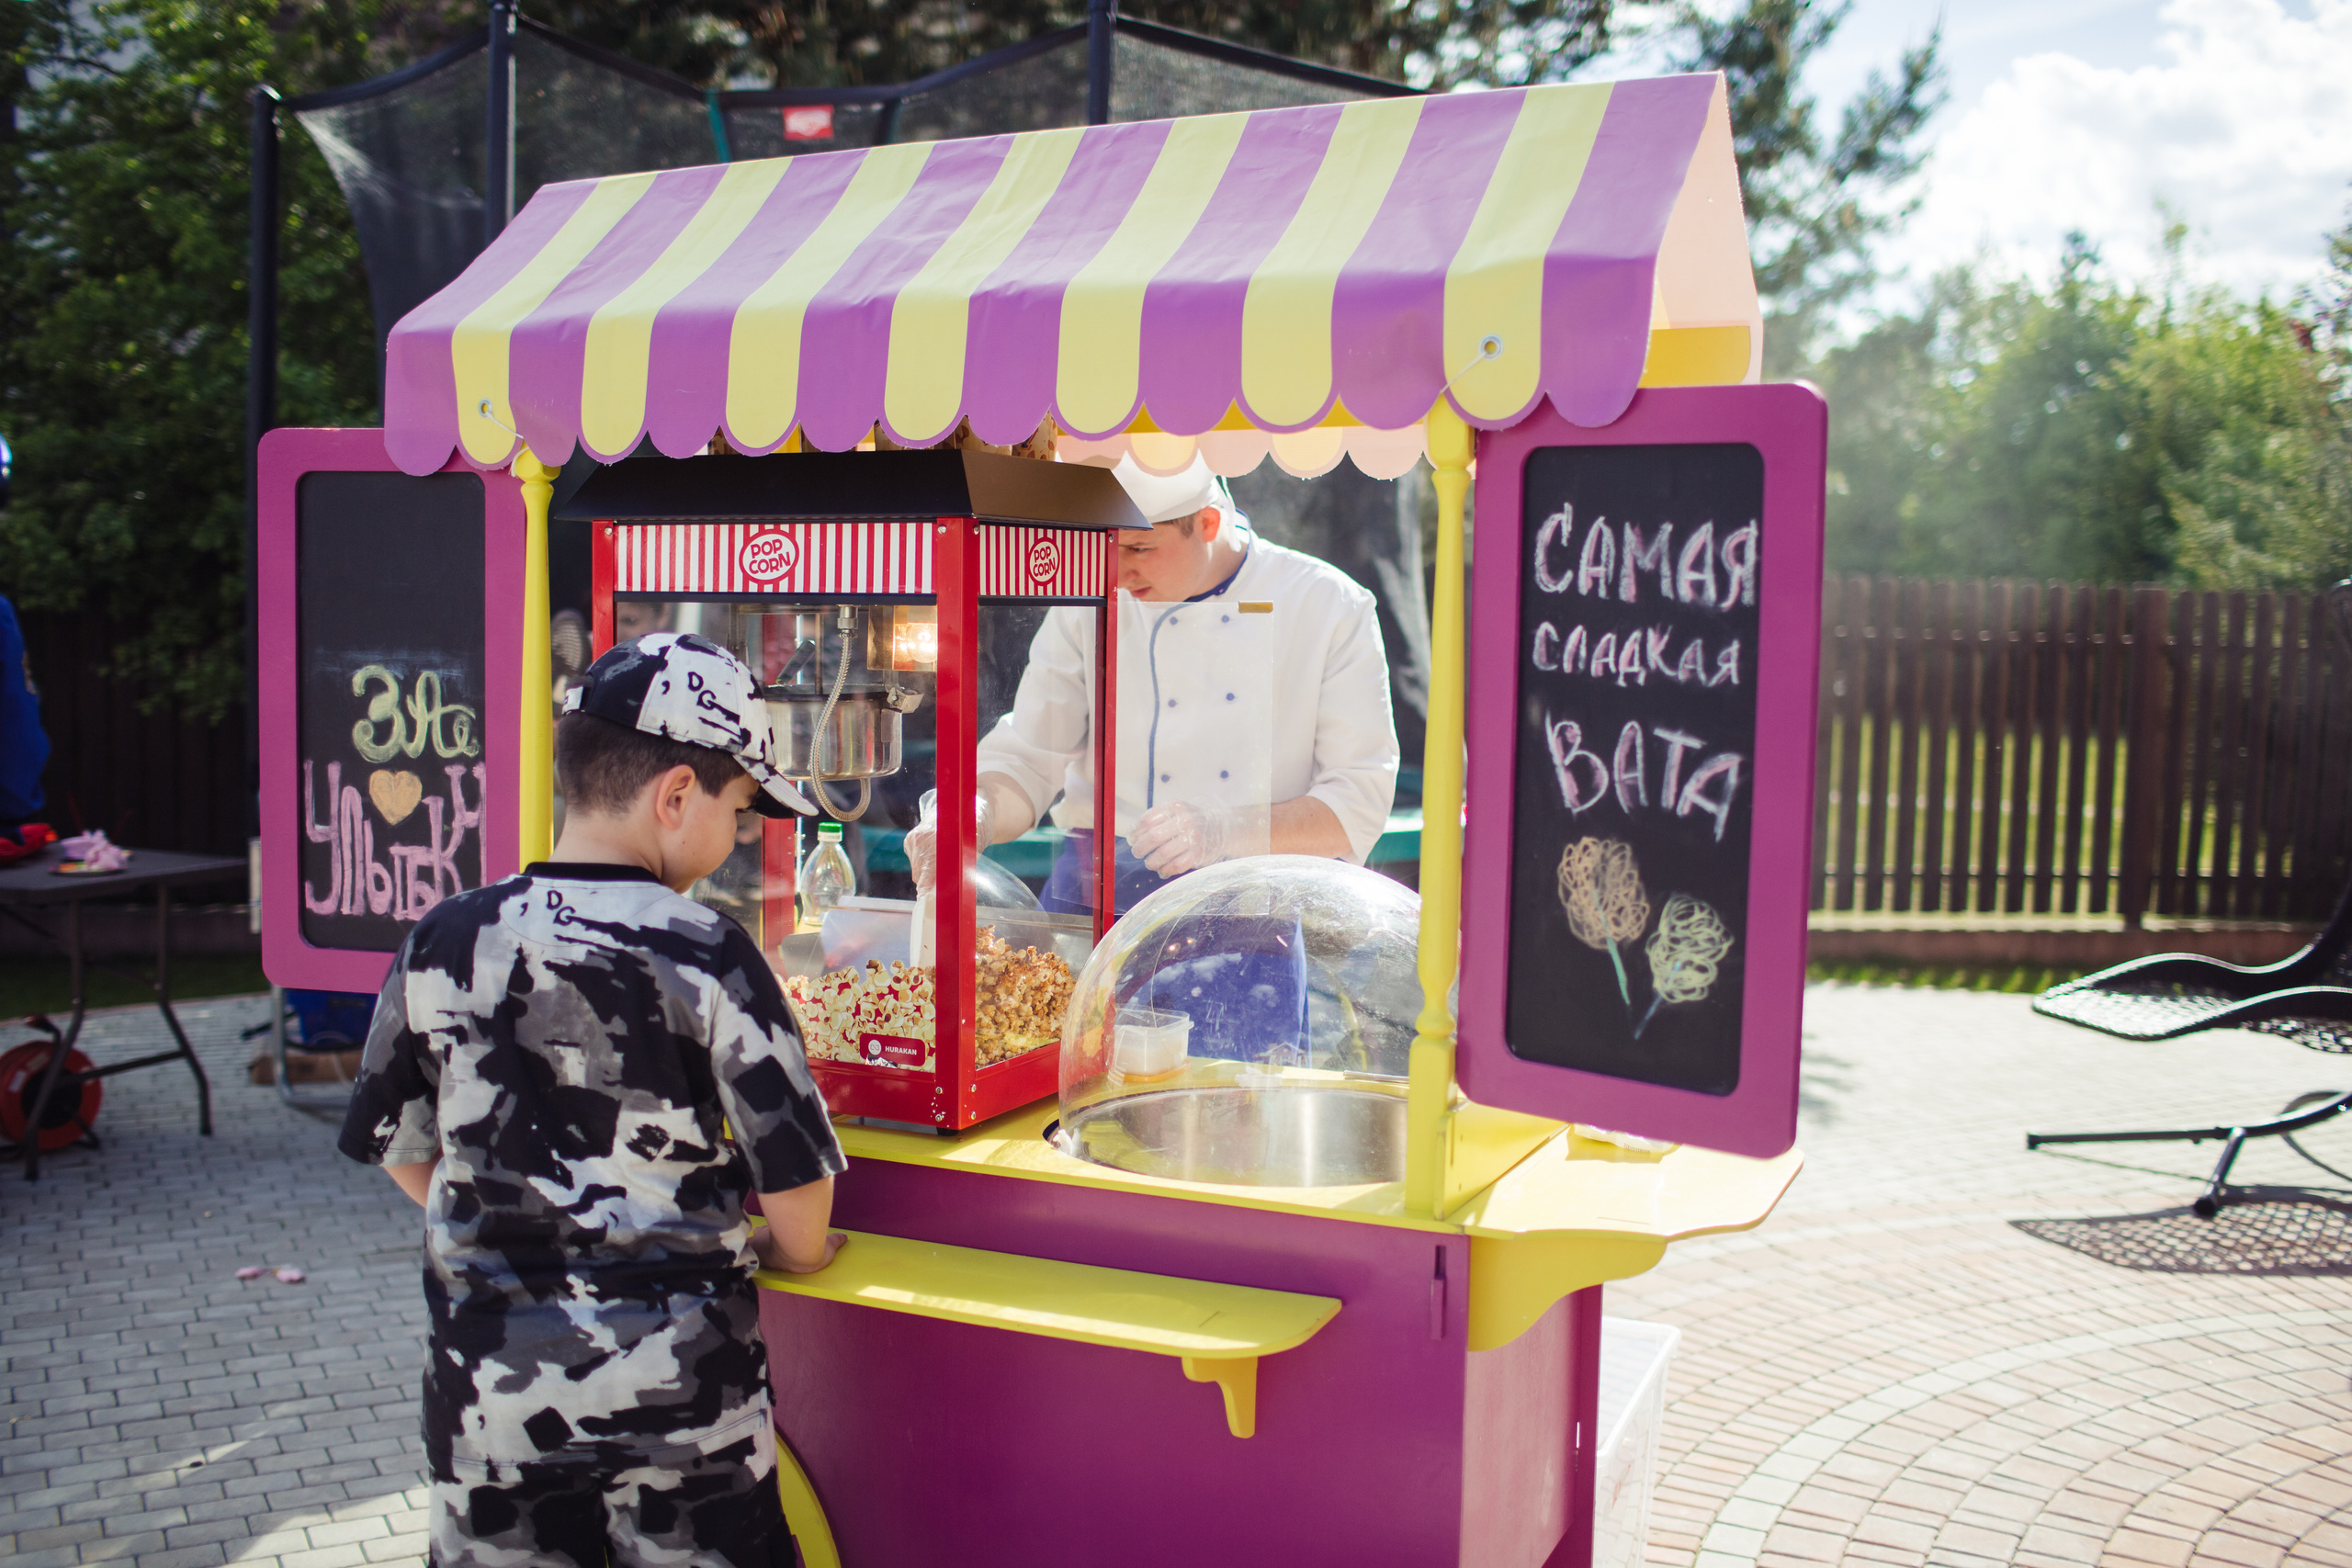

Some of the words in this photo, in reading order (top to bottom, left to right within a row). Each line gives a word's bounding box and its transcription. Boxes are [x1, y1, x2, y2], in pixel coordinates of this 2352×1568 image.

[750, 538, 783, 559] POP
[1034, 546, 1052, 563] POP
[1533, 502, 1758, 612] САМАЯ
[749, 551, 791, 574] CORN
[1033, 557, 1056, 577] CORN
[1532, 621, 1741, 687] СЛАДКАЯ
[1544, 707, 1744, 842] ВАТА
[885, 1045, 917, 1055] HURAKAN
